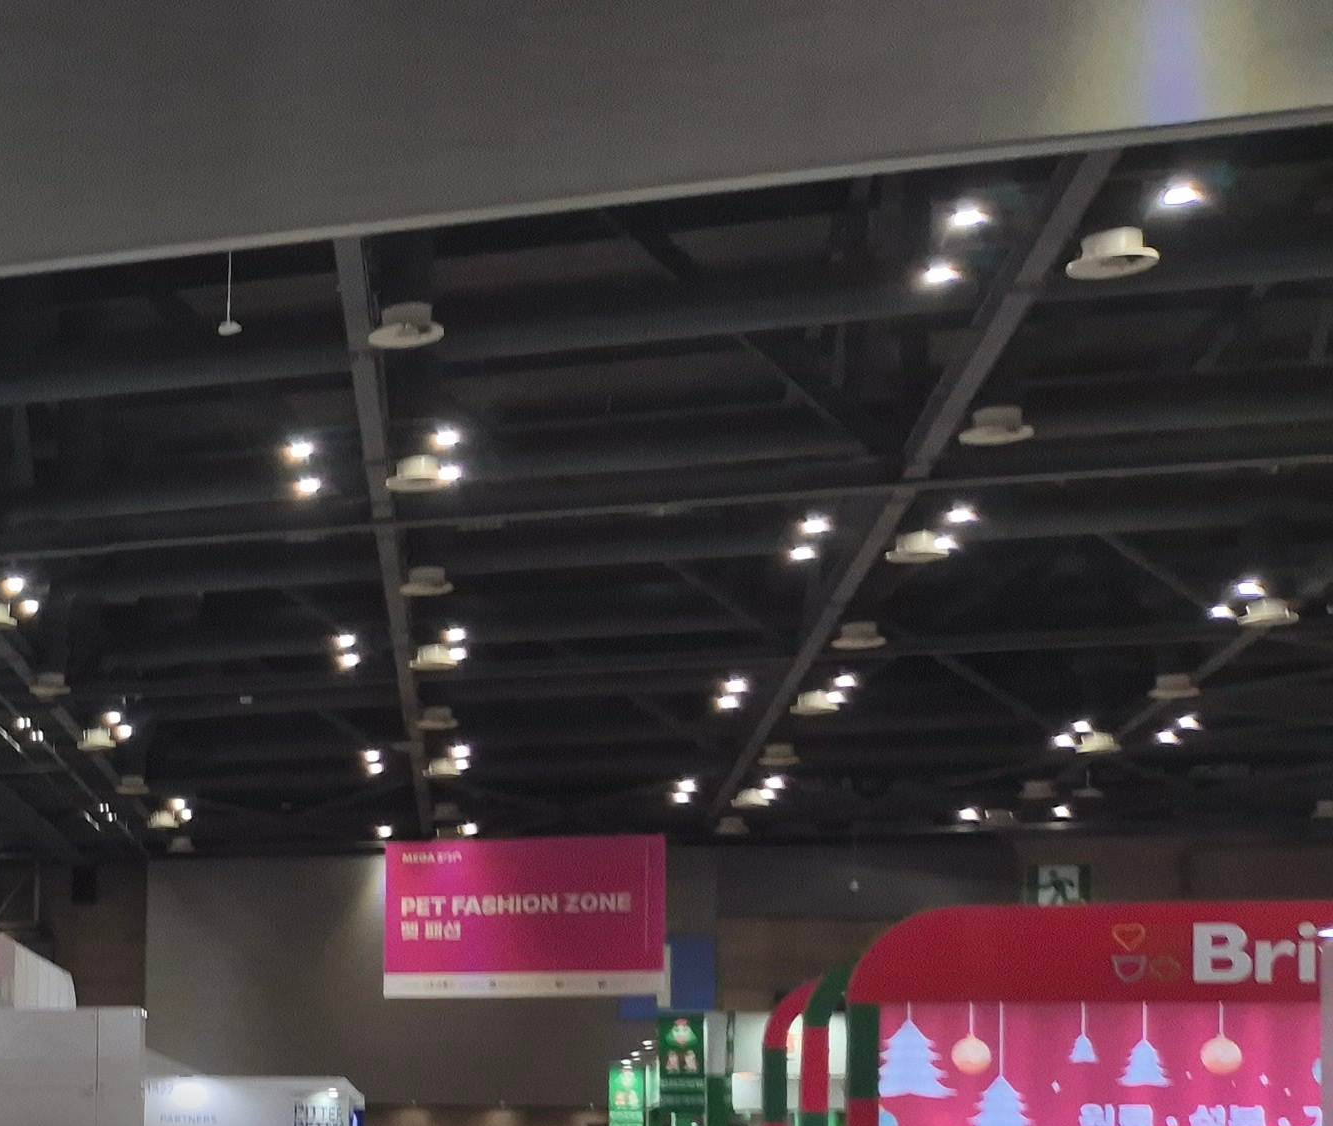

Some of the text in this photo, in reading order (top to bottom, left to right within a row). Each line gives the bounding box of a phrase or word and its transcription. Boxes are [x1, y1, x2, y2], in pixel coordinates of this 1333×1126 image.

[400, 891, 632, 917] PET FASHION ZONE
[1192, 920, 1322, 985] Bri
[159, 1113, 218, 1125] PARTNERS
